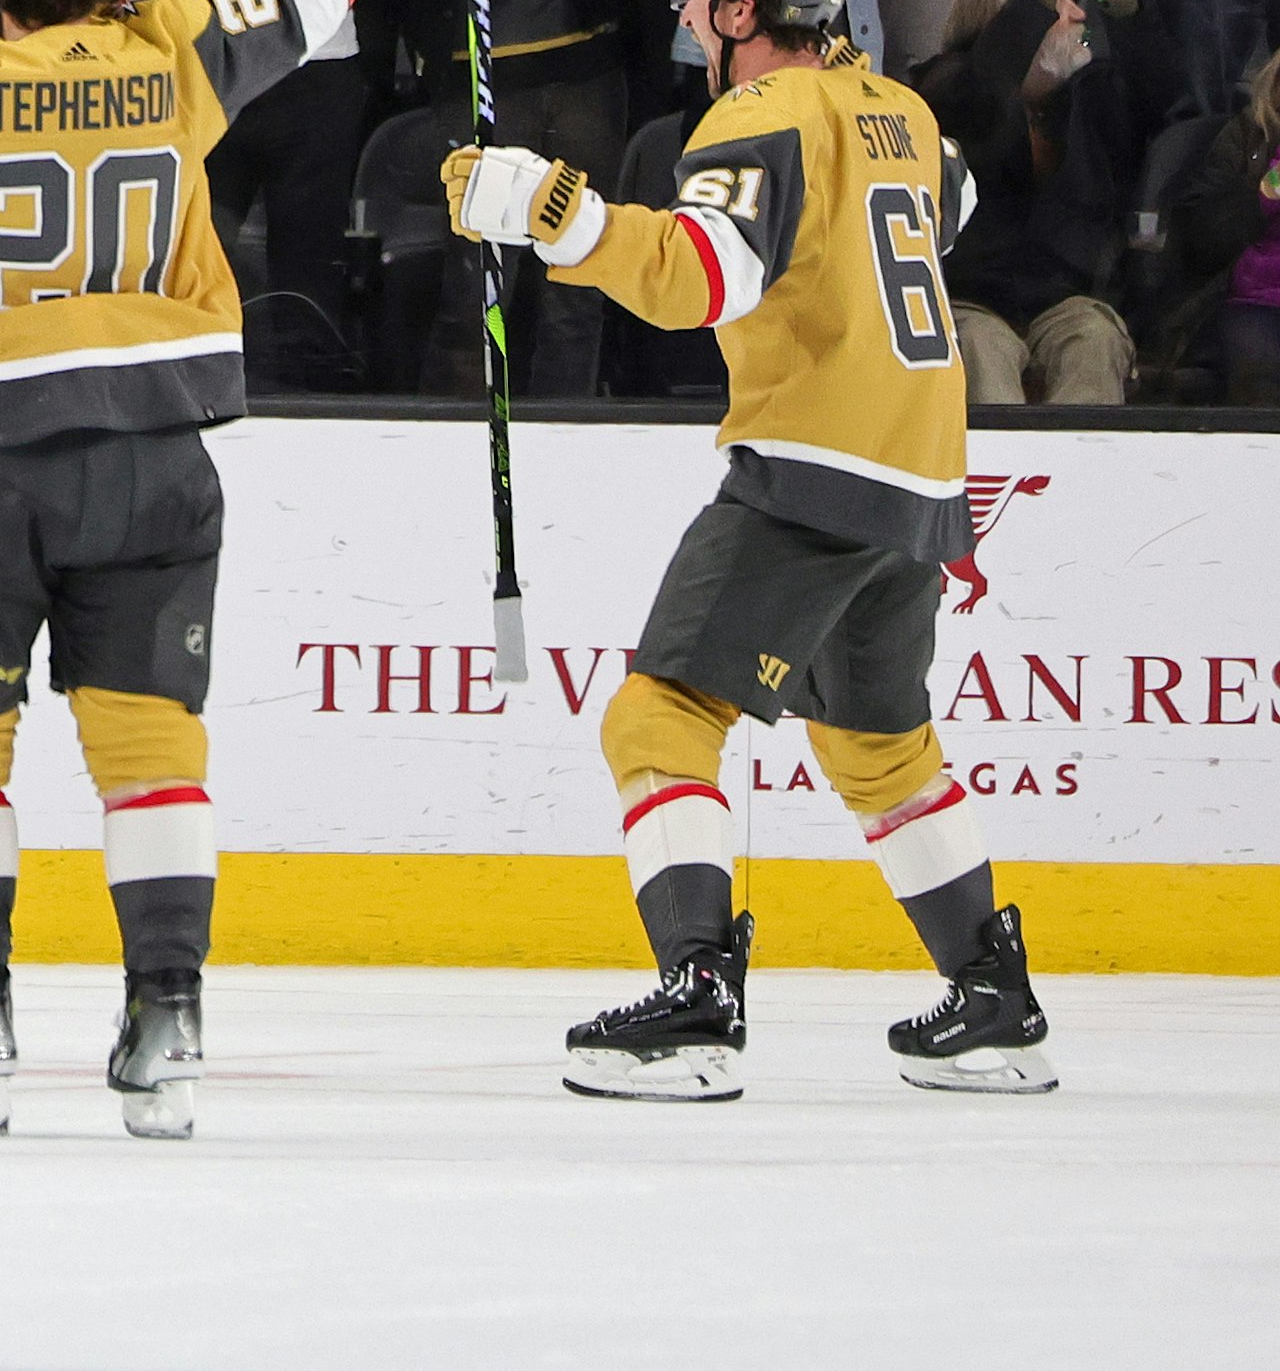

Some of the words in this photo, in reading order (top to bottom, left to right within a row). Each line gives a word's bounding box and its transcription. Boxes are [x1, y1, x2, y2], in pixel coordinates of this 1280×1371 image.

[678, 166, 765, 222] 61
[295, 642, 508, 715] THE
[932, 1021, 968, 1044] BAUER
